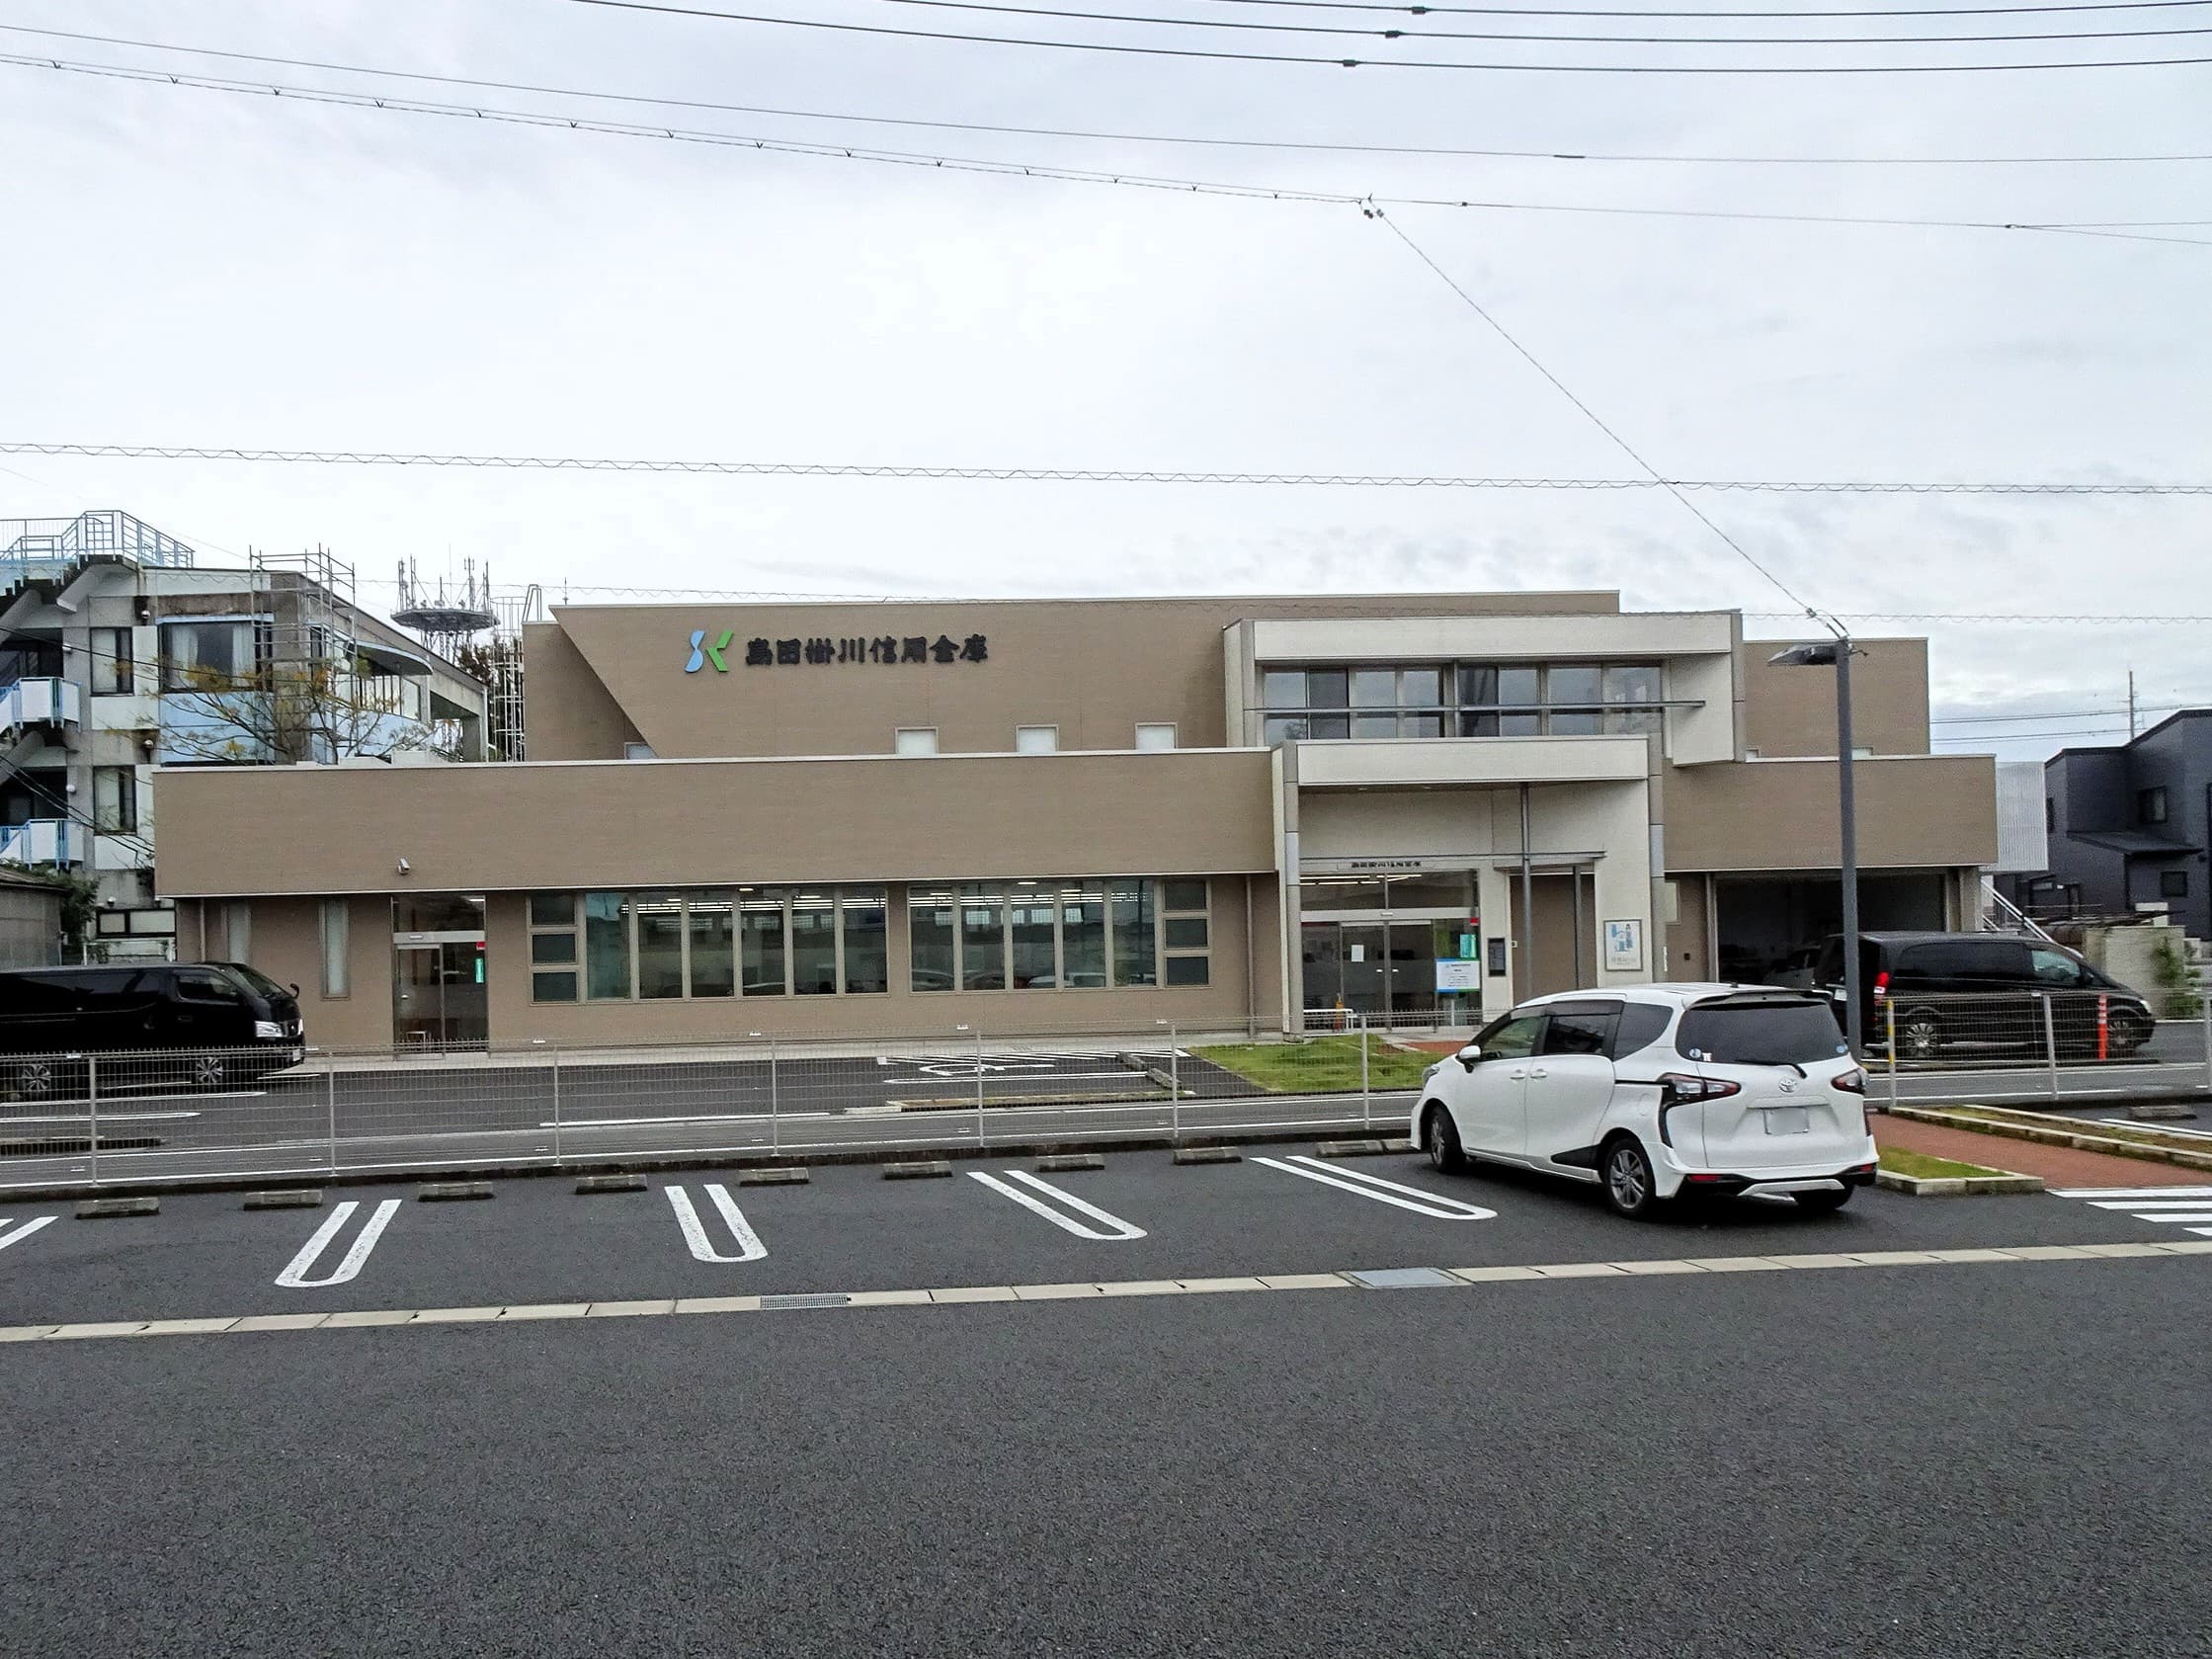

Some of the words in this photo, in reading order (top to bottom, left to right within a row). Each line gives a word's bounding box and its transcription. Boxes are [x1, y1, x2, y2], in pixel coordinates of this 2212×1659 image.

[746, 633, 988, 666] 島田掛川信用金庫
